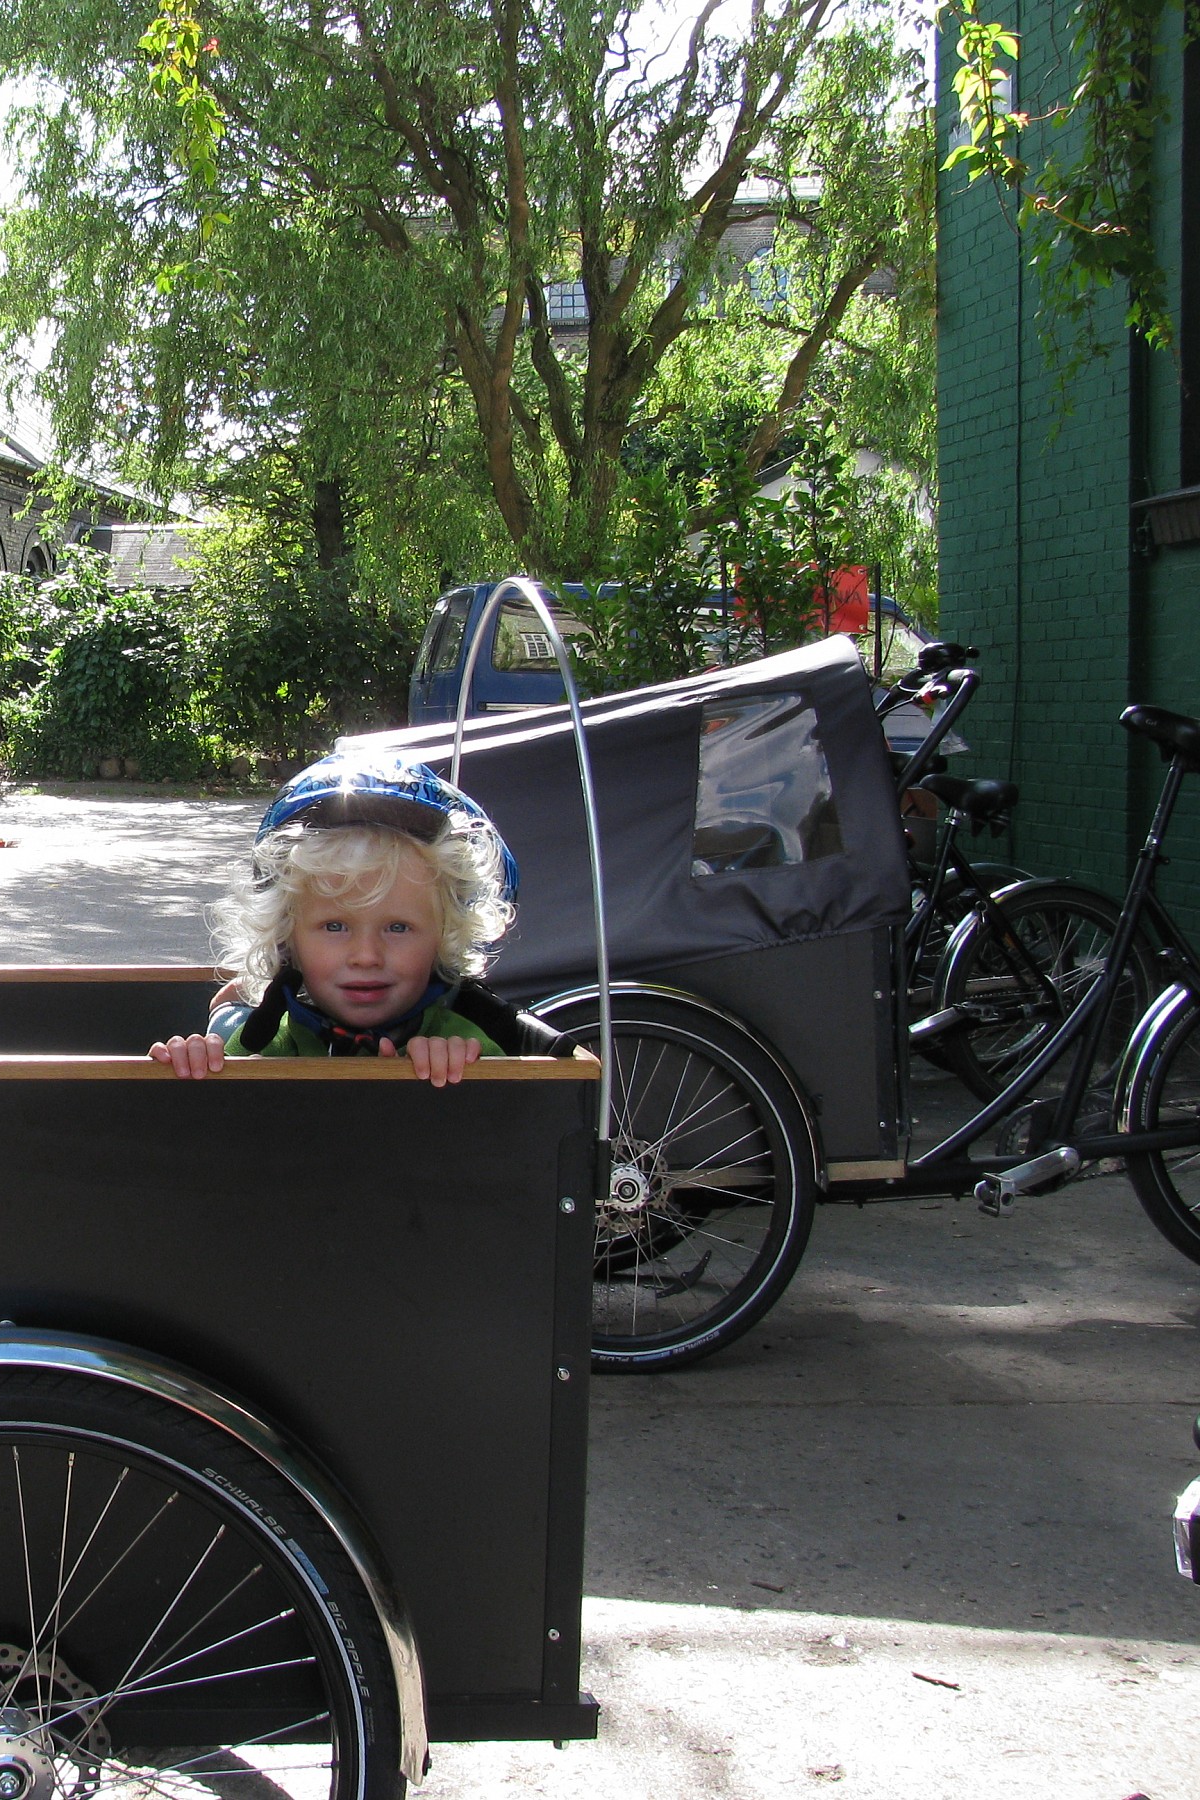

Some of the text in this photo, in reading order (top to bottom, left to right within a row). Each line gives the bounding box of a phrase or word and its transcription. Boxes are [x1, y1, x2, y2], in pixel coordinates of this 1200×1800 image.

[201, 1467, 370, 1698] SCHWALBE BIG APPLE
